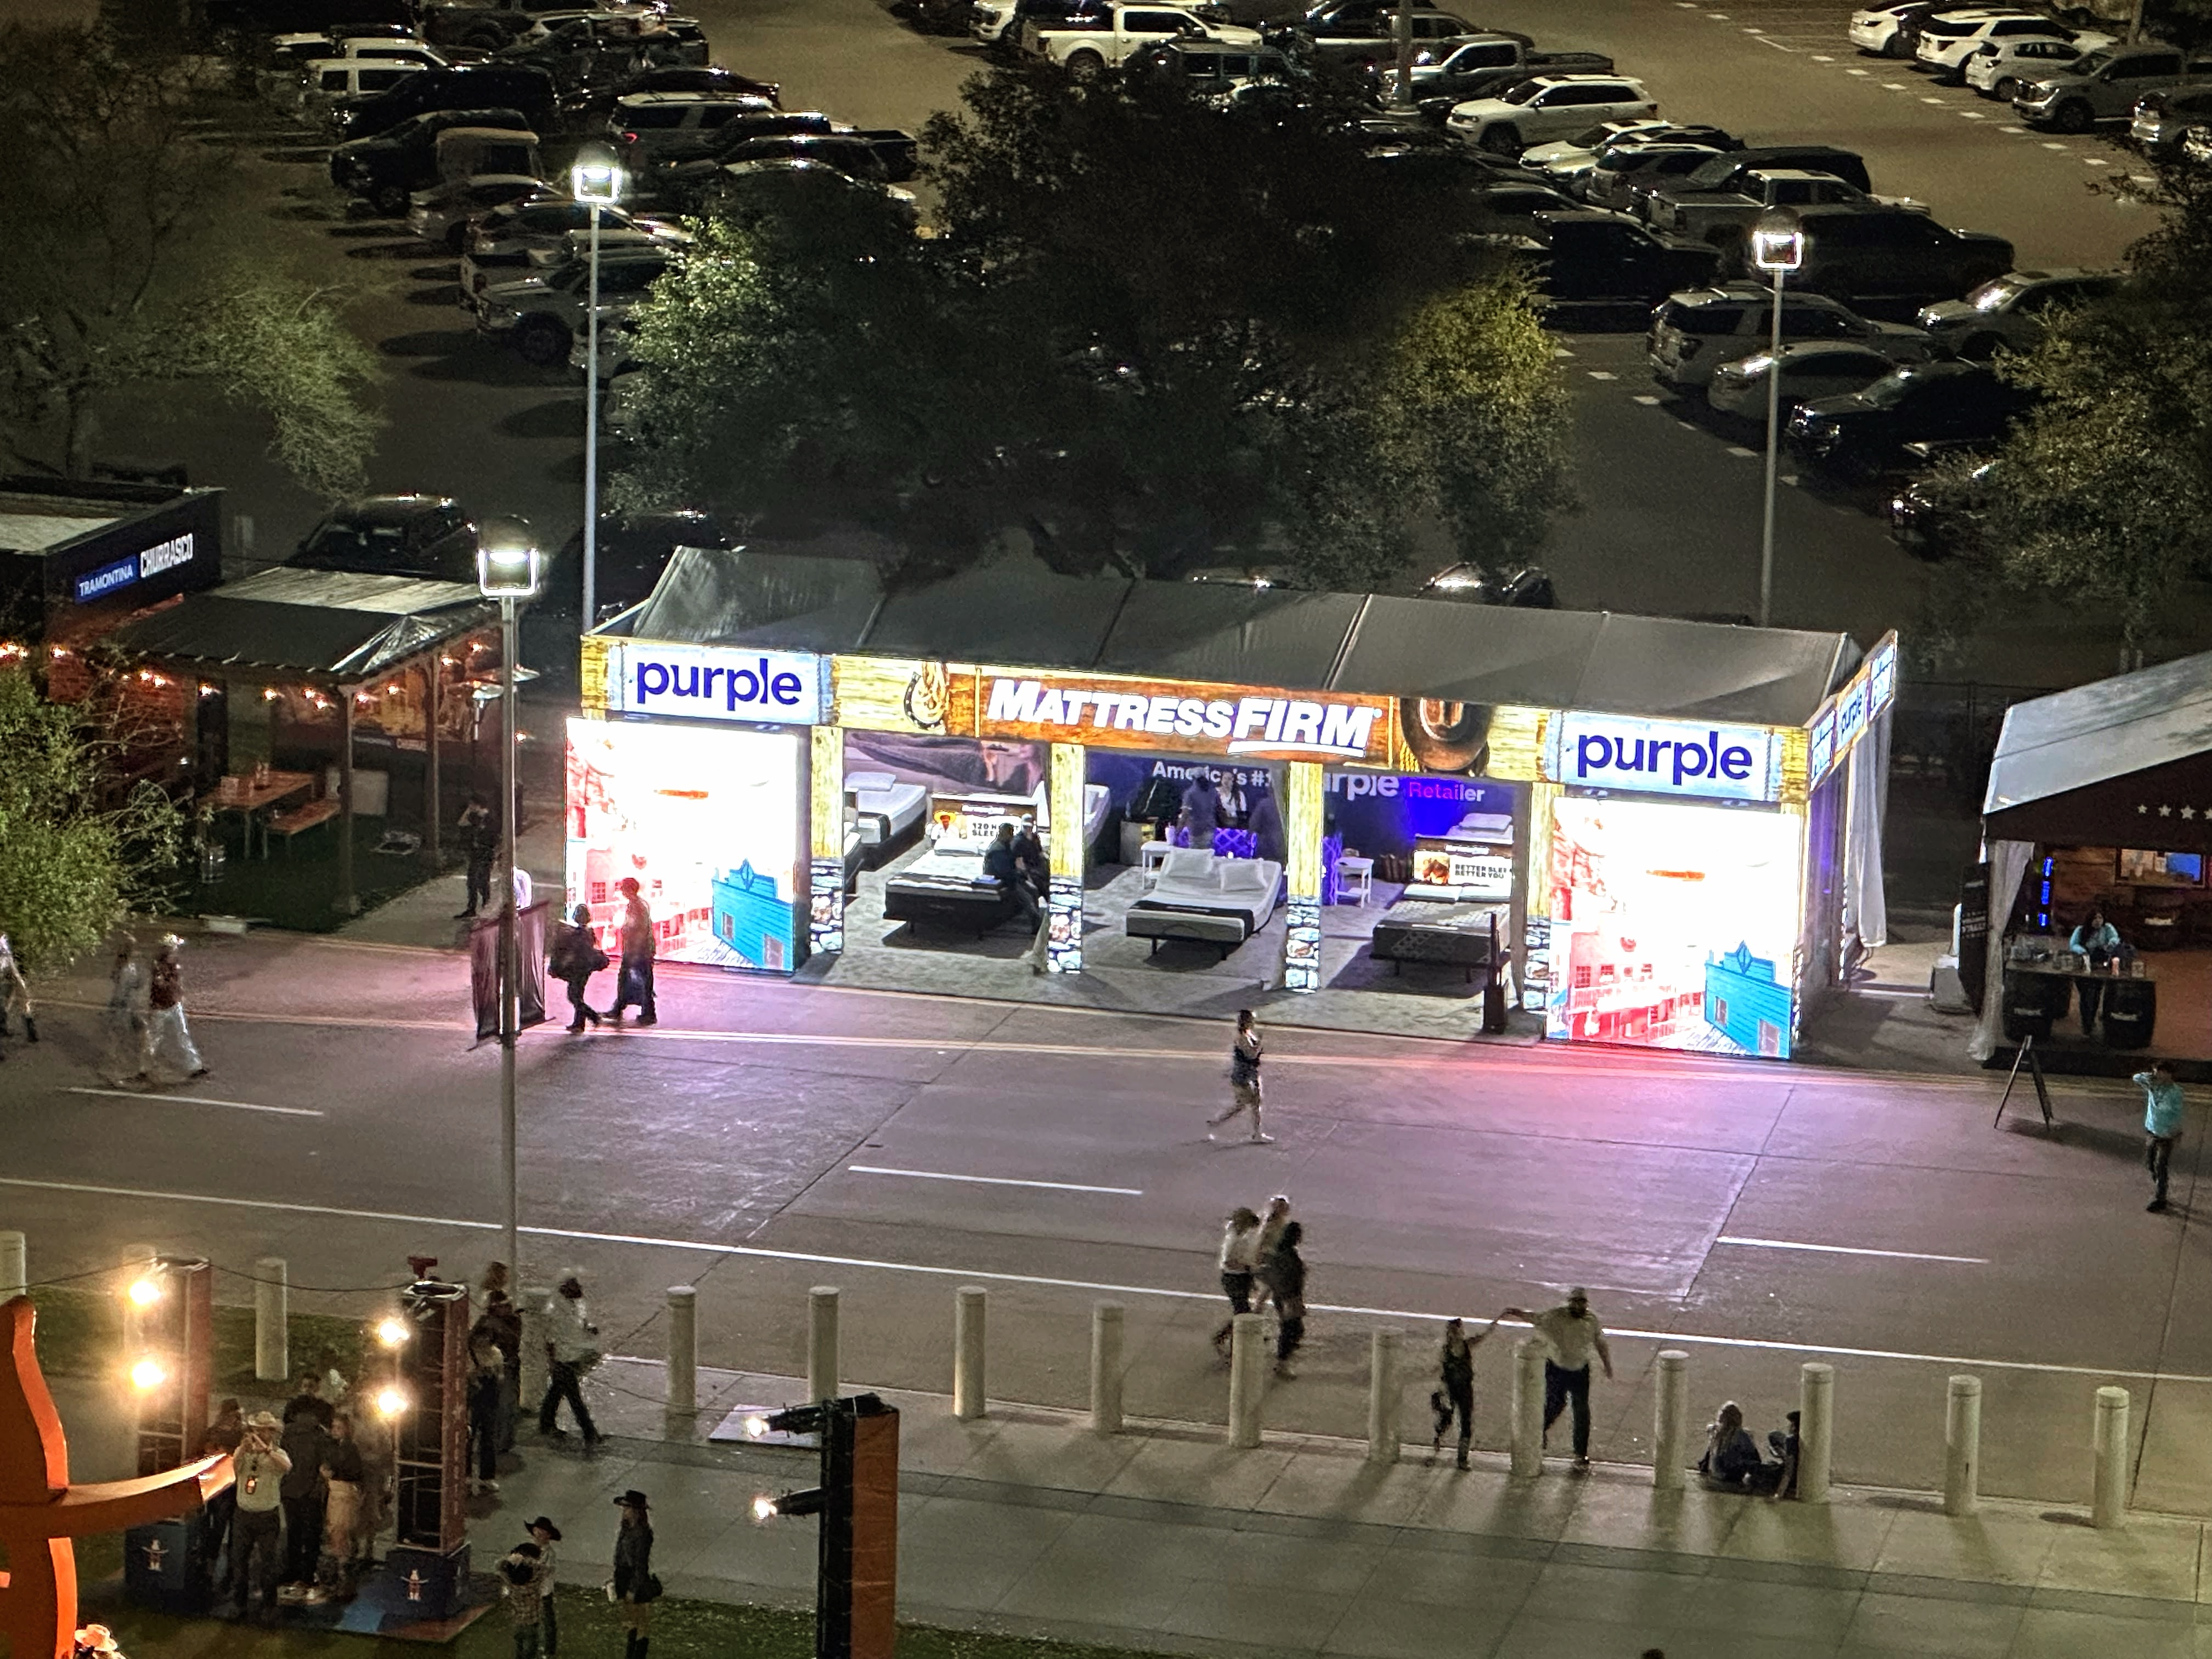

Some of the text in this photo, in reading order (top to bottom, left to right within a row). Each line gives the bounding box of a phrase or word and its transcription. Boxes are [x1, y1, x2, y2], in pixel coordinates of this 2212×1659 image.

[80, 533, 193, 597] TRAMONTINA CHURRASCO
[637, 658, 802, 712] purple
[1578, 731, 1752, 786] purple
[1409, 782, 1485, 802] Retailer
